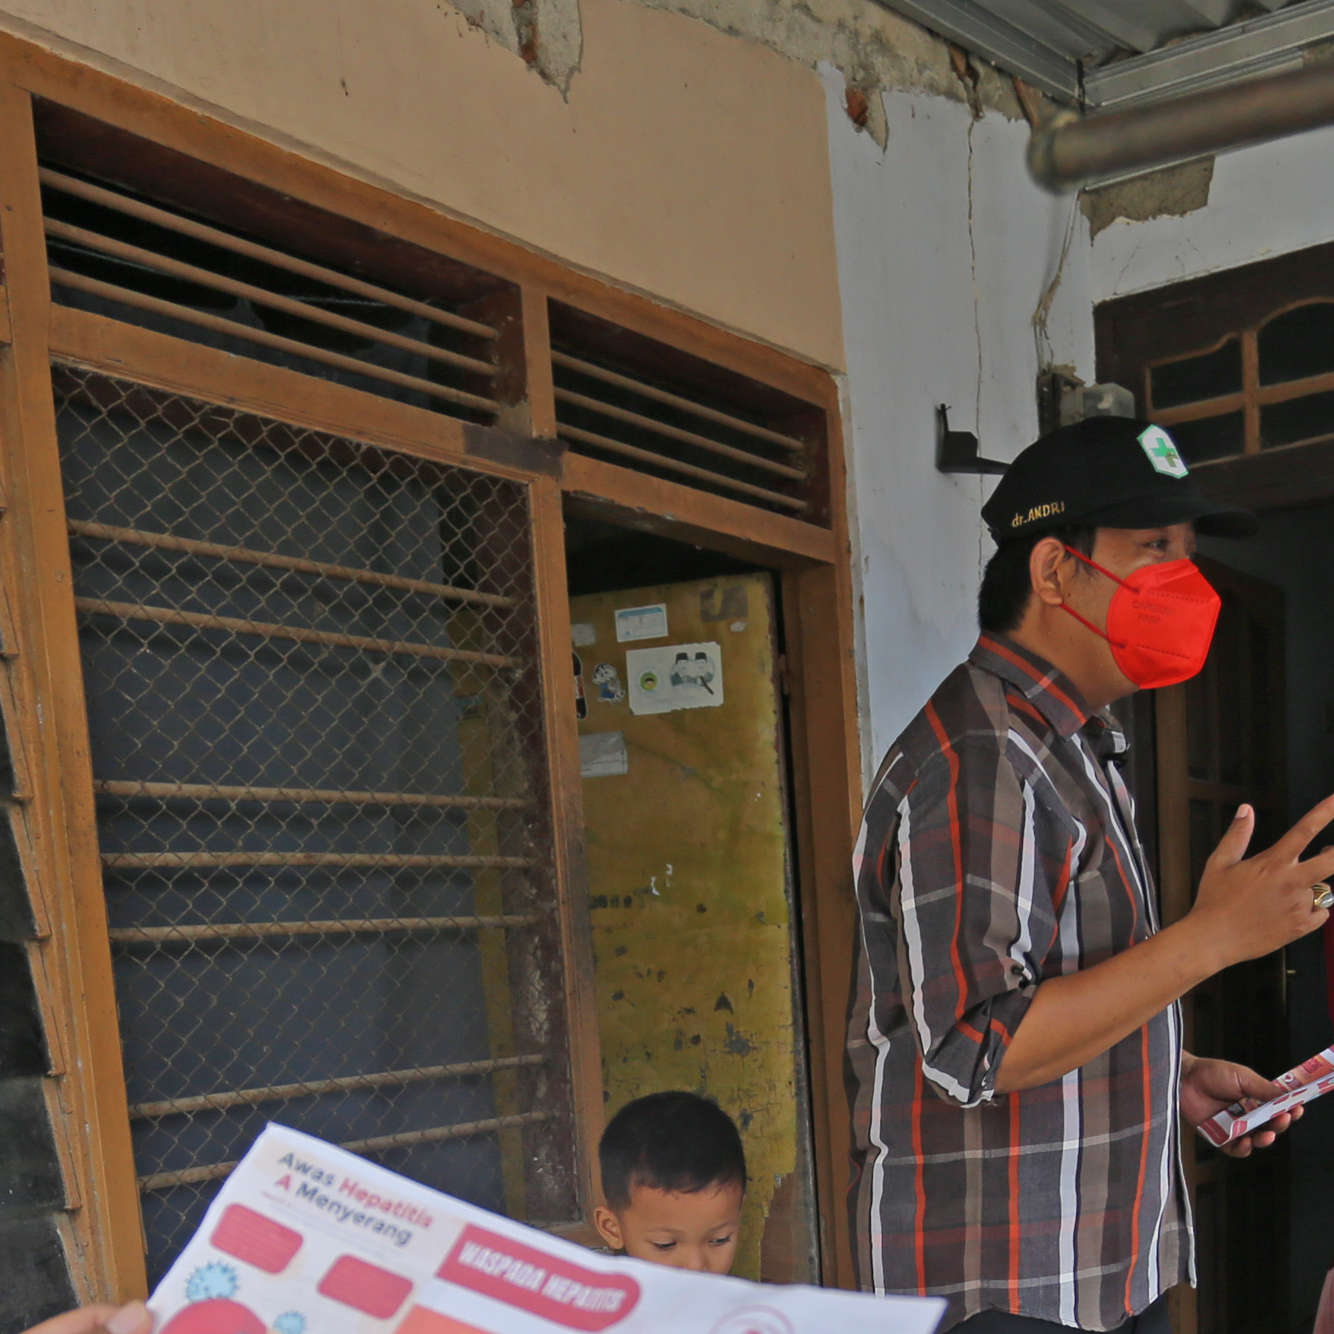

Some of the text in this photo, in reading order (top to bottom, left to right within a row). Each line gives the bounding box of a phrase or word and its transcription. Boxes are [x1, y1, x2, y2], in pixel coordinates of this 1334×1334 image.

[273, 1174, 414, 1250] A Menyerang
[276, 1151, 435, 1231] Awas Hepatitis
[458, 1240, 543, 1295] WASPADA
